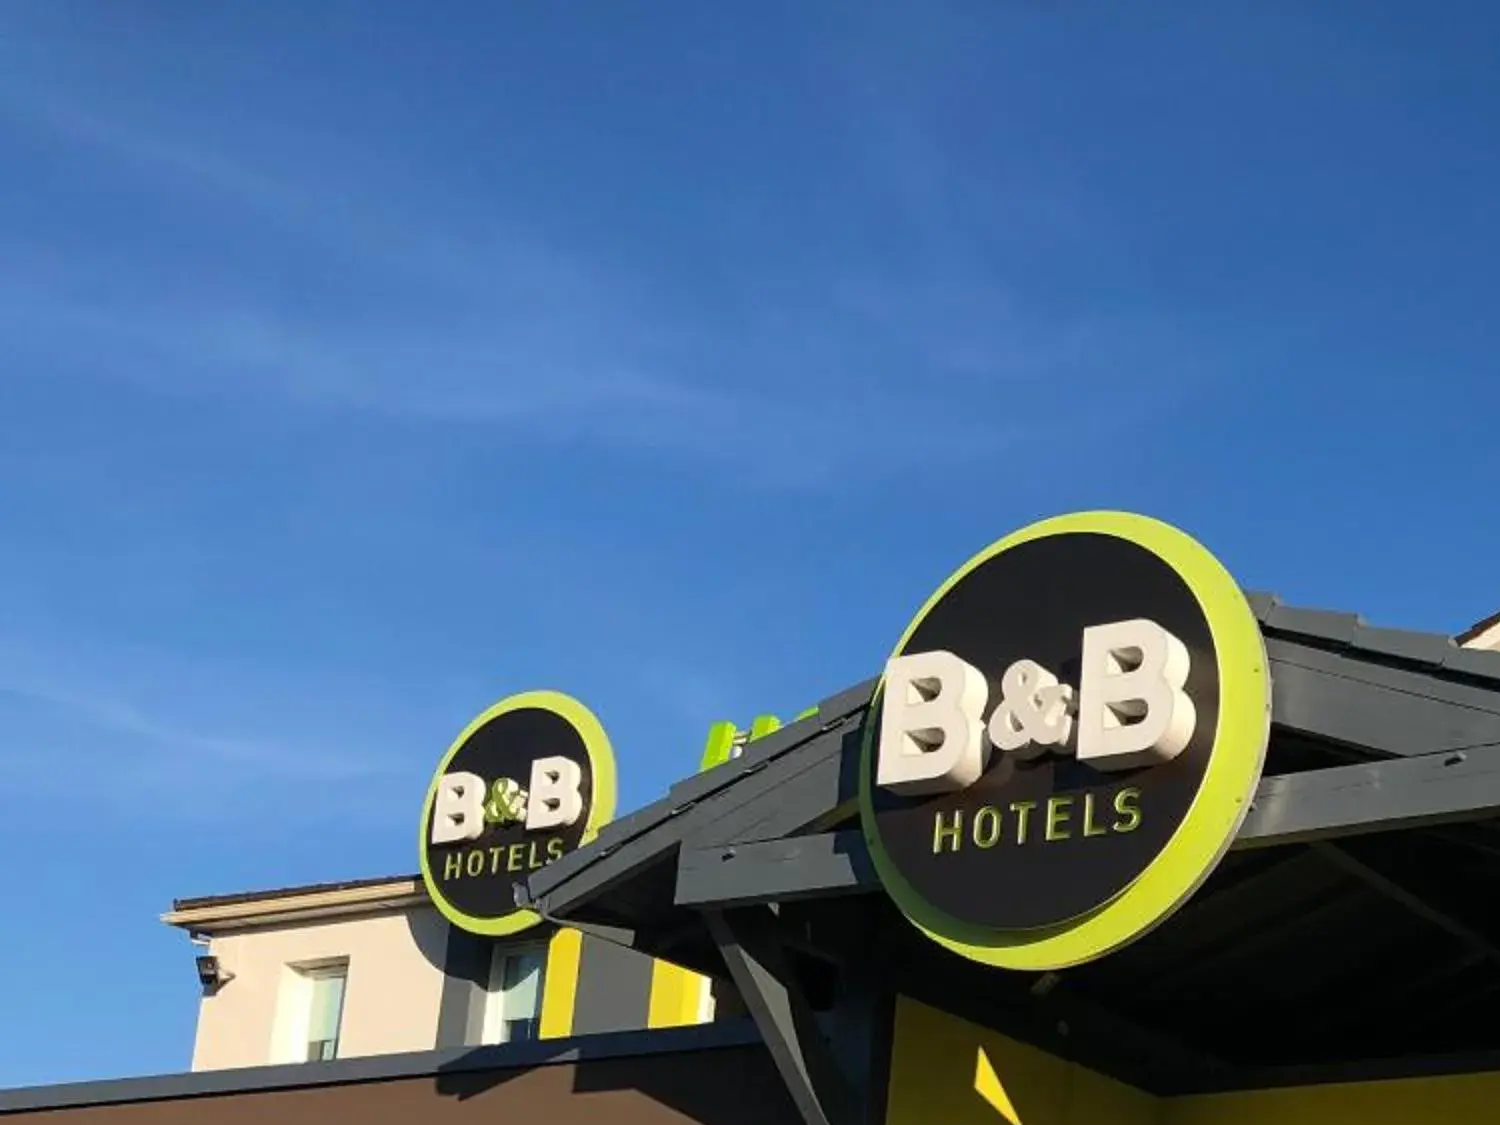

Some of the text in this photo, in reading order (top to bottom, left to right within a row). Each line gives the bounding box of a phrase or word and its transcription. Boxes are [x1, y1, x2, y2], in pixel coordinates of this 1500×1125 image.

[877, 618, 1197, 796] B&B
[432, 755, 583, 844] B&B
[932, 787, 1144, 854] HOTELS
[443, 837, 565, 880] HOTELS
